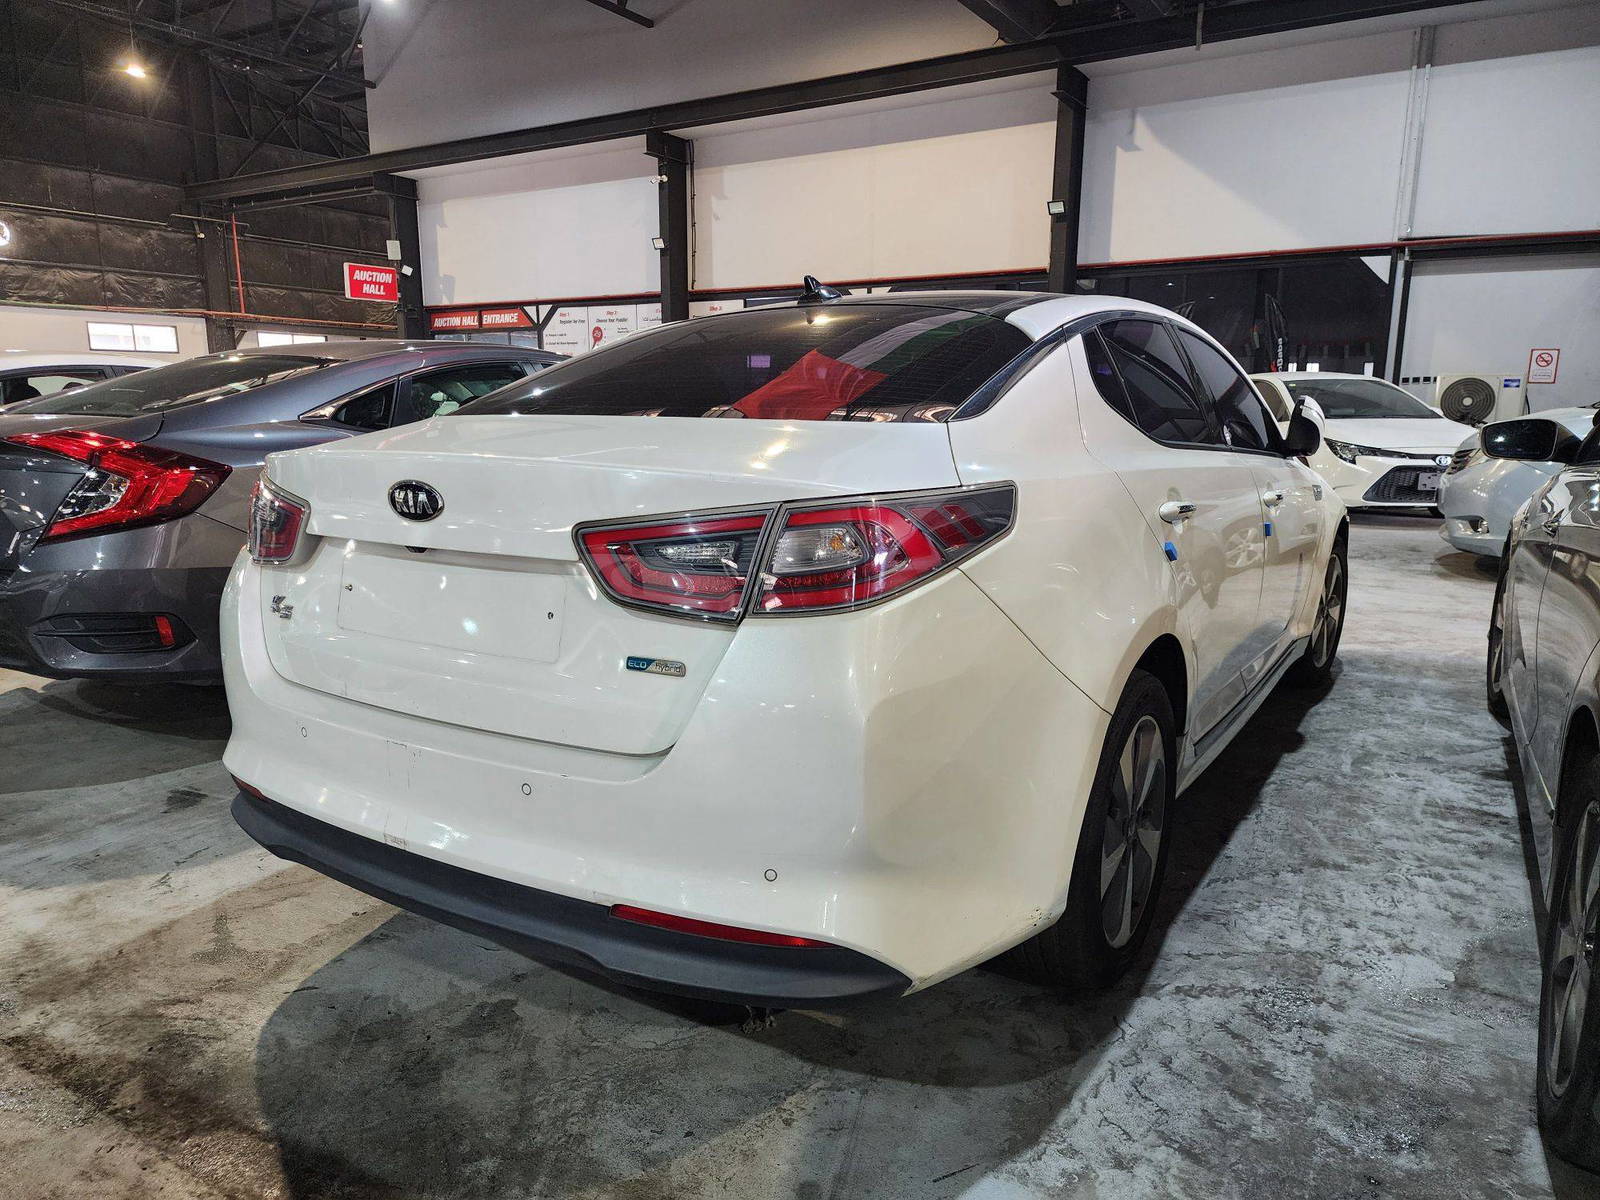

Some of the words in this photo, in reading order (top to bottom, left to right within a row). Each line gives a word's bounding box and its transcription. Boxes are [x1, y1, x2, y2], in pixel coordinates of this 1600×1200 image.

[353, 269, 392, 283] AUCTION
[362, 283, 386, 295] HALL
[434, 317, 461, 327] AUCTION
[462, 315, 478, 326] HALL
[483, 313, 519, 324] ENTRANCE
[393, 488, 434, 514] KIA
[628, 660, 647, 669] ECO
[655, 661, 681, 673] hybrid
